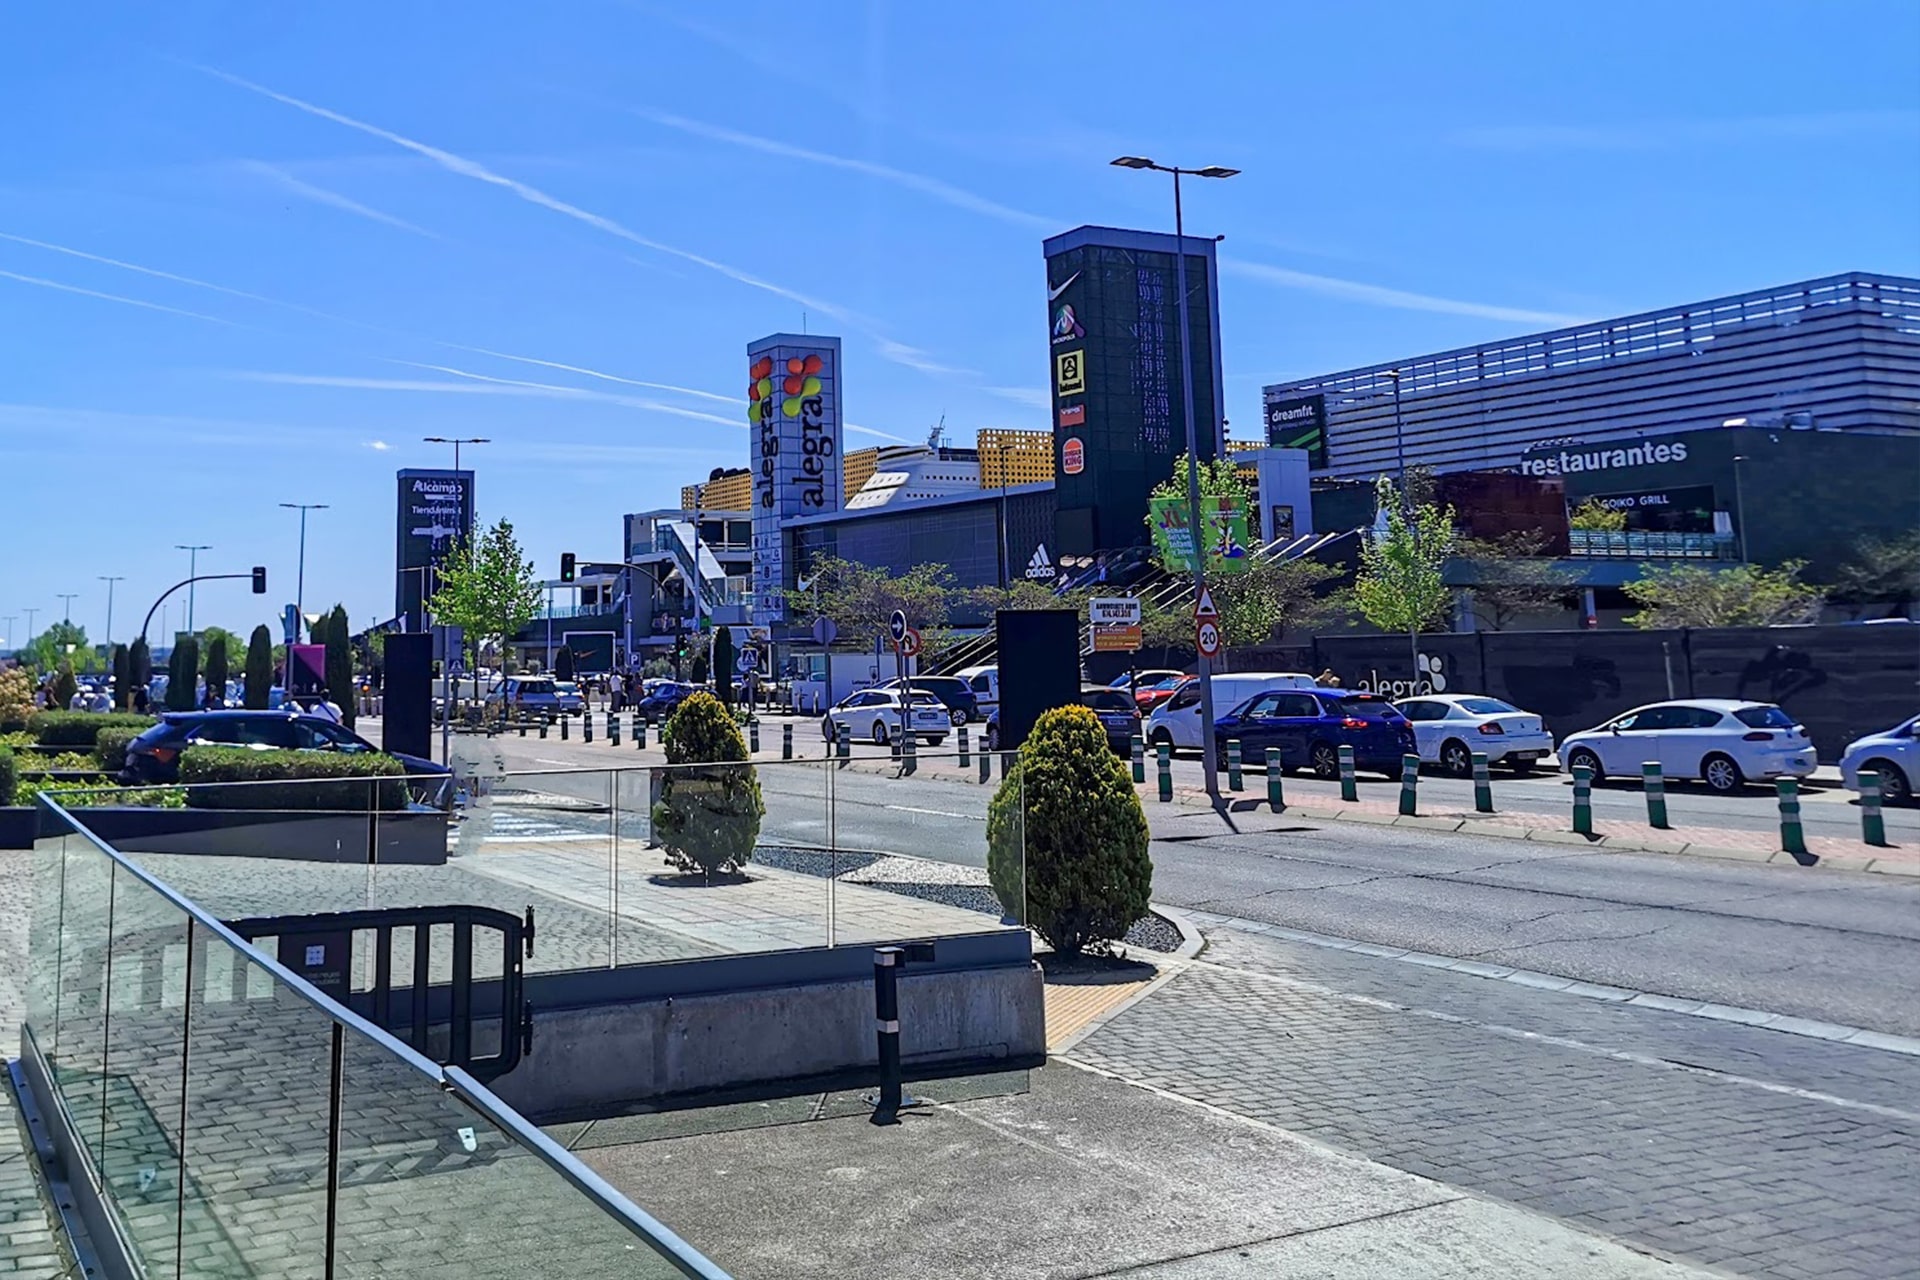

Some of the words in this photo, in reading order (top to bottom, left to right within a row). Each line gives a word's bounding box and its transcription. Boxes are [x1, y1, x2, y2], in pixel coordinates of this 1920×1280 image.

[756, 396, 779, 509] alegra
[791, 395, 834, 508] alegra
[1521, 441, 1688, 476] restaurantes
[1064, 456, 1082, 467] KING
[412, 480, 463, 494] Alcampo
[1639, 494, 1670, 506] GRILL
[1025, 566, 1055, 578] adidas
[1202, 631, 1216, 645] 20
[631, 655, 638, 665] P
